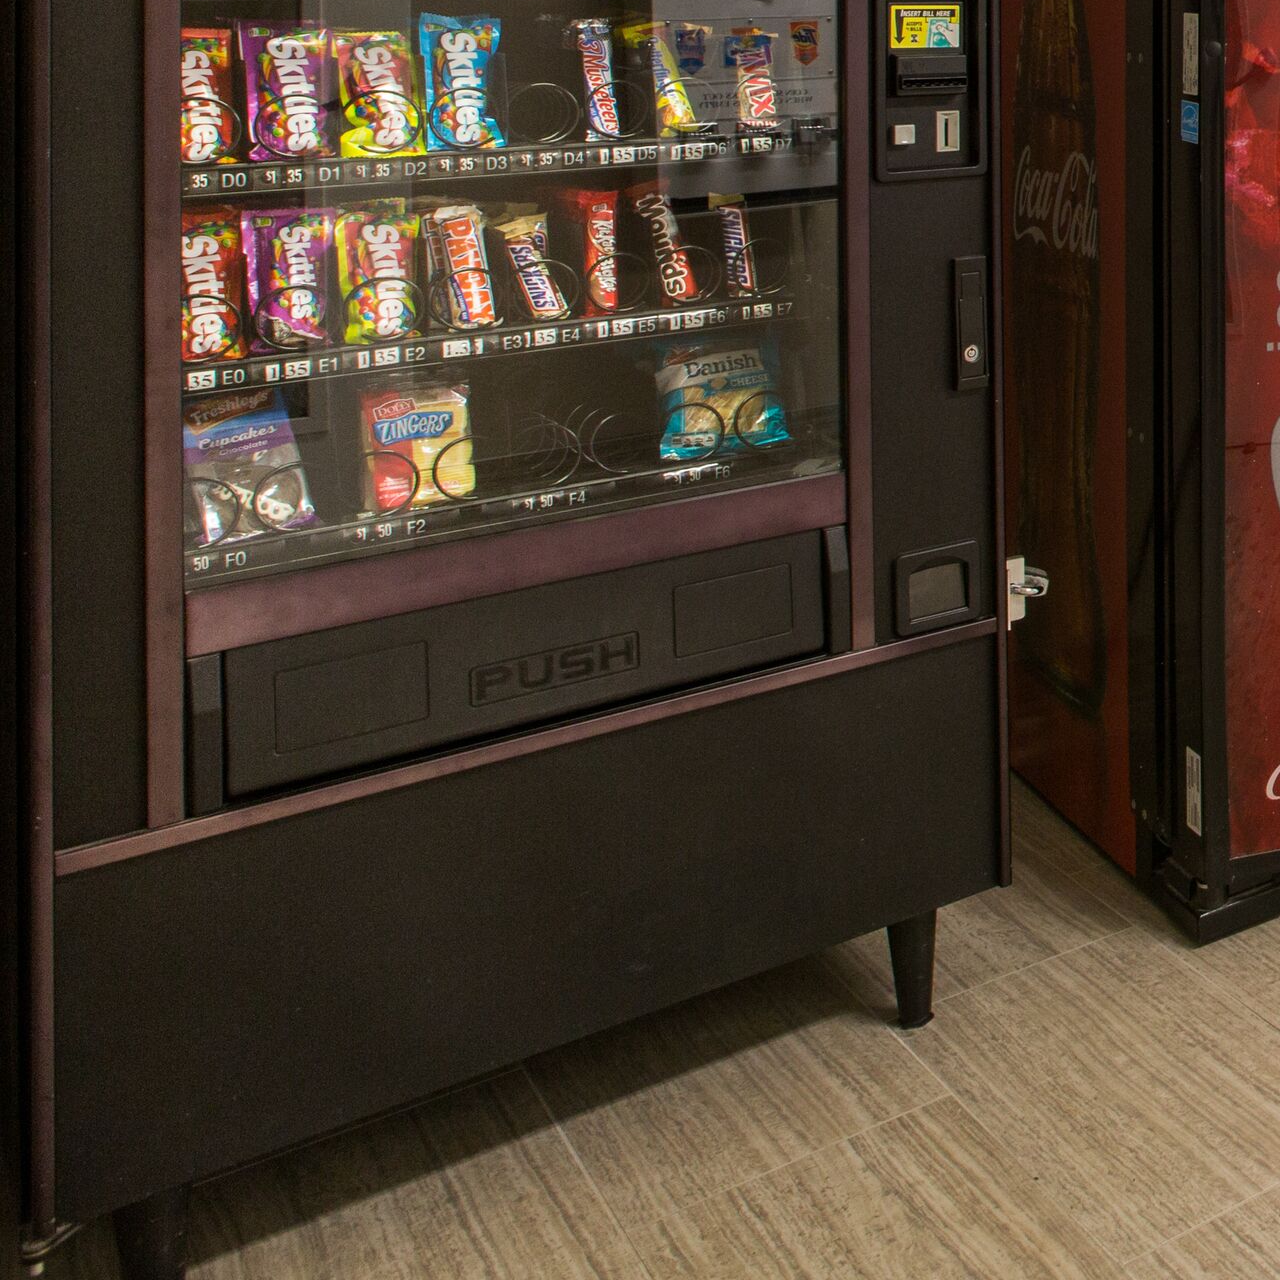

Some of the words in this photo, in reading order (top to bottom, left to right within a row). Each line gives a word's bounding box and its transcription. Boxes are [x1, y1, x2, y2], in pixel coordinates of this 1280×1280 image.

[900, 9, 922, 17] INSERT
[267, 37, 318, 151] Skittles
[354, 45, 408, 147] Skittles
[440, 31, 482, 144] Skittles
[584, 52, 620, 133] Musketeers
[182, 50, 222, 161] Skittles
[638, 146, 656, 160] D5
[706, 141, 727, 156] D6
[742, 137, 772, 153] 1.35
[775, 137, 791, 152] D7
[440, 157, 474, 173] $1.35
[486, 156, 509, 171] D3
[564, 151, 584, 165] D4
[266, 168, 303, 185] $1.35
[319, 166, 342, 182] D1
[356, 163, 390, 178] $1.35
[404, 161, 427, 177] D2
[221, 172, 247, 189] D0
[278, 225, 317, 320] Skittles
[361, 223, 403, 336] Skittles
[182, 235, 227, 354] Skittles
[709, 309, 726, 323] E6
[777, 302, 793, 316] E7
[638, 318, 656, 333] E5
[502, 333, 522, 350] E3
[562, 328, 581, 343] E4
[359, 348, 398, 367] 1.35
[405, 346, 426, 361] E2
[268, 362, 310, 380] 1.35
[319, 357, 338, 372] E1
[684, 353, 759, 380] Danish
[222, 369, 245, 385] E0
[375, 400, 413, 419] DOLLY
[198, 424, 277, 451] Cupcakes
[219, 439, 269, 457] Chocolate
[715, 465, 731, 479] F6
[569, 490, 586, 506] F4
[406, 519, 426, 535] F2
[225, 551, 247, 568] F0
[476, 638, 636, 700] PUSH
